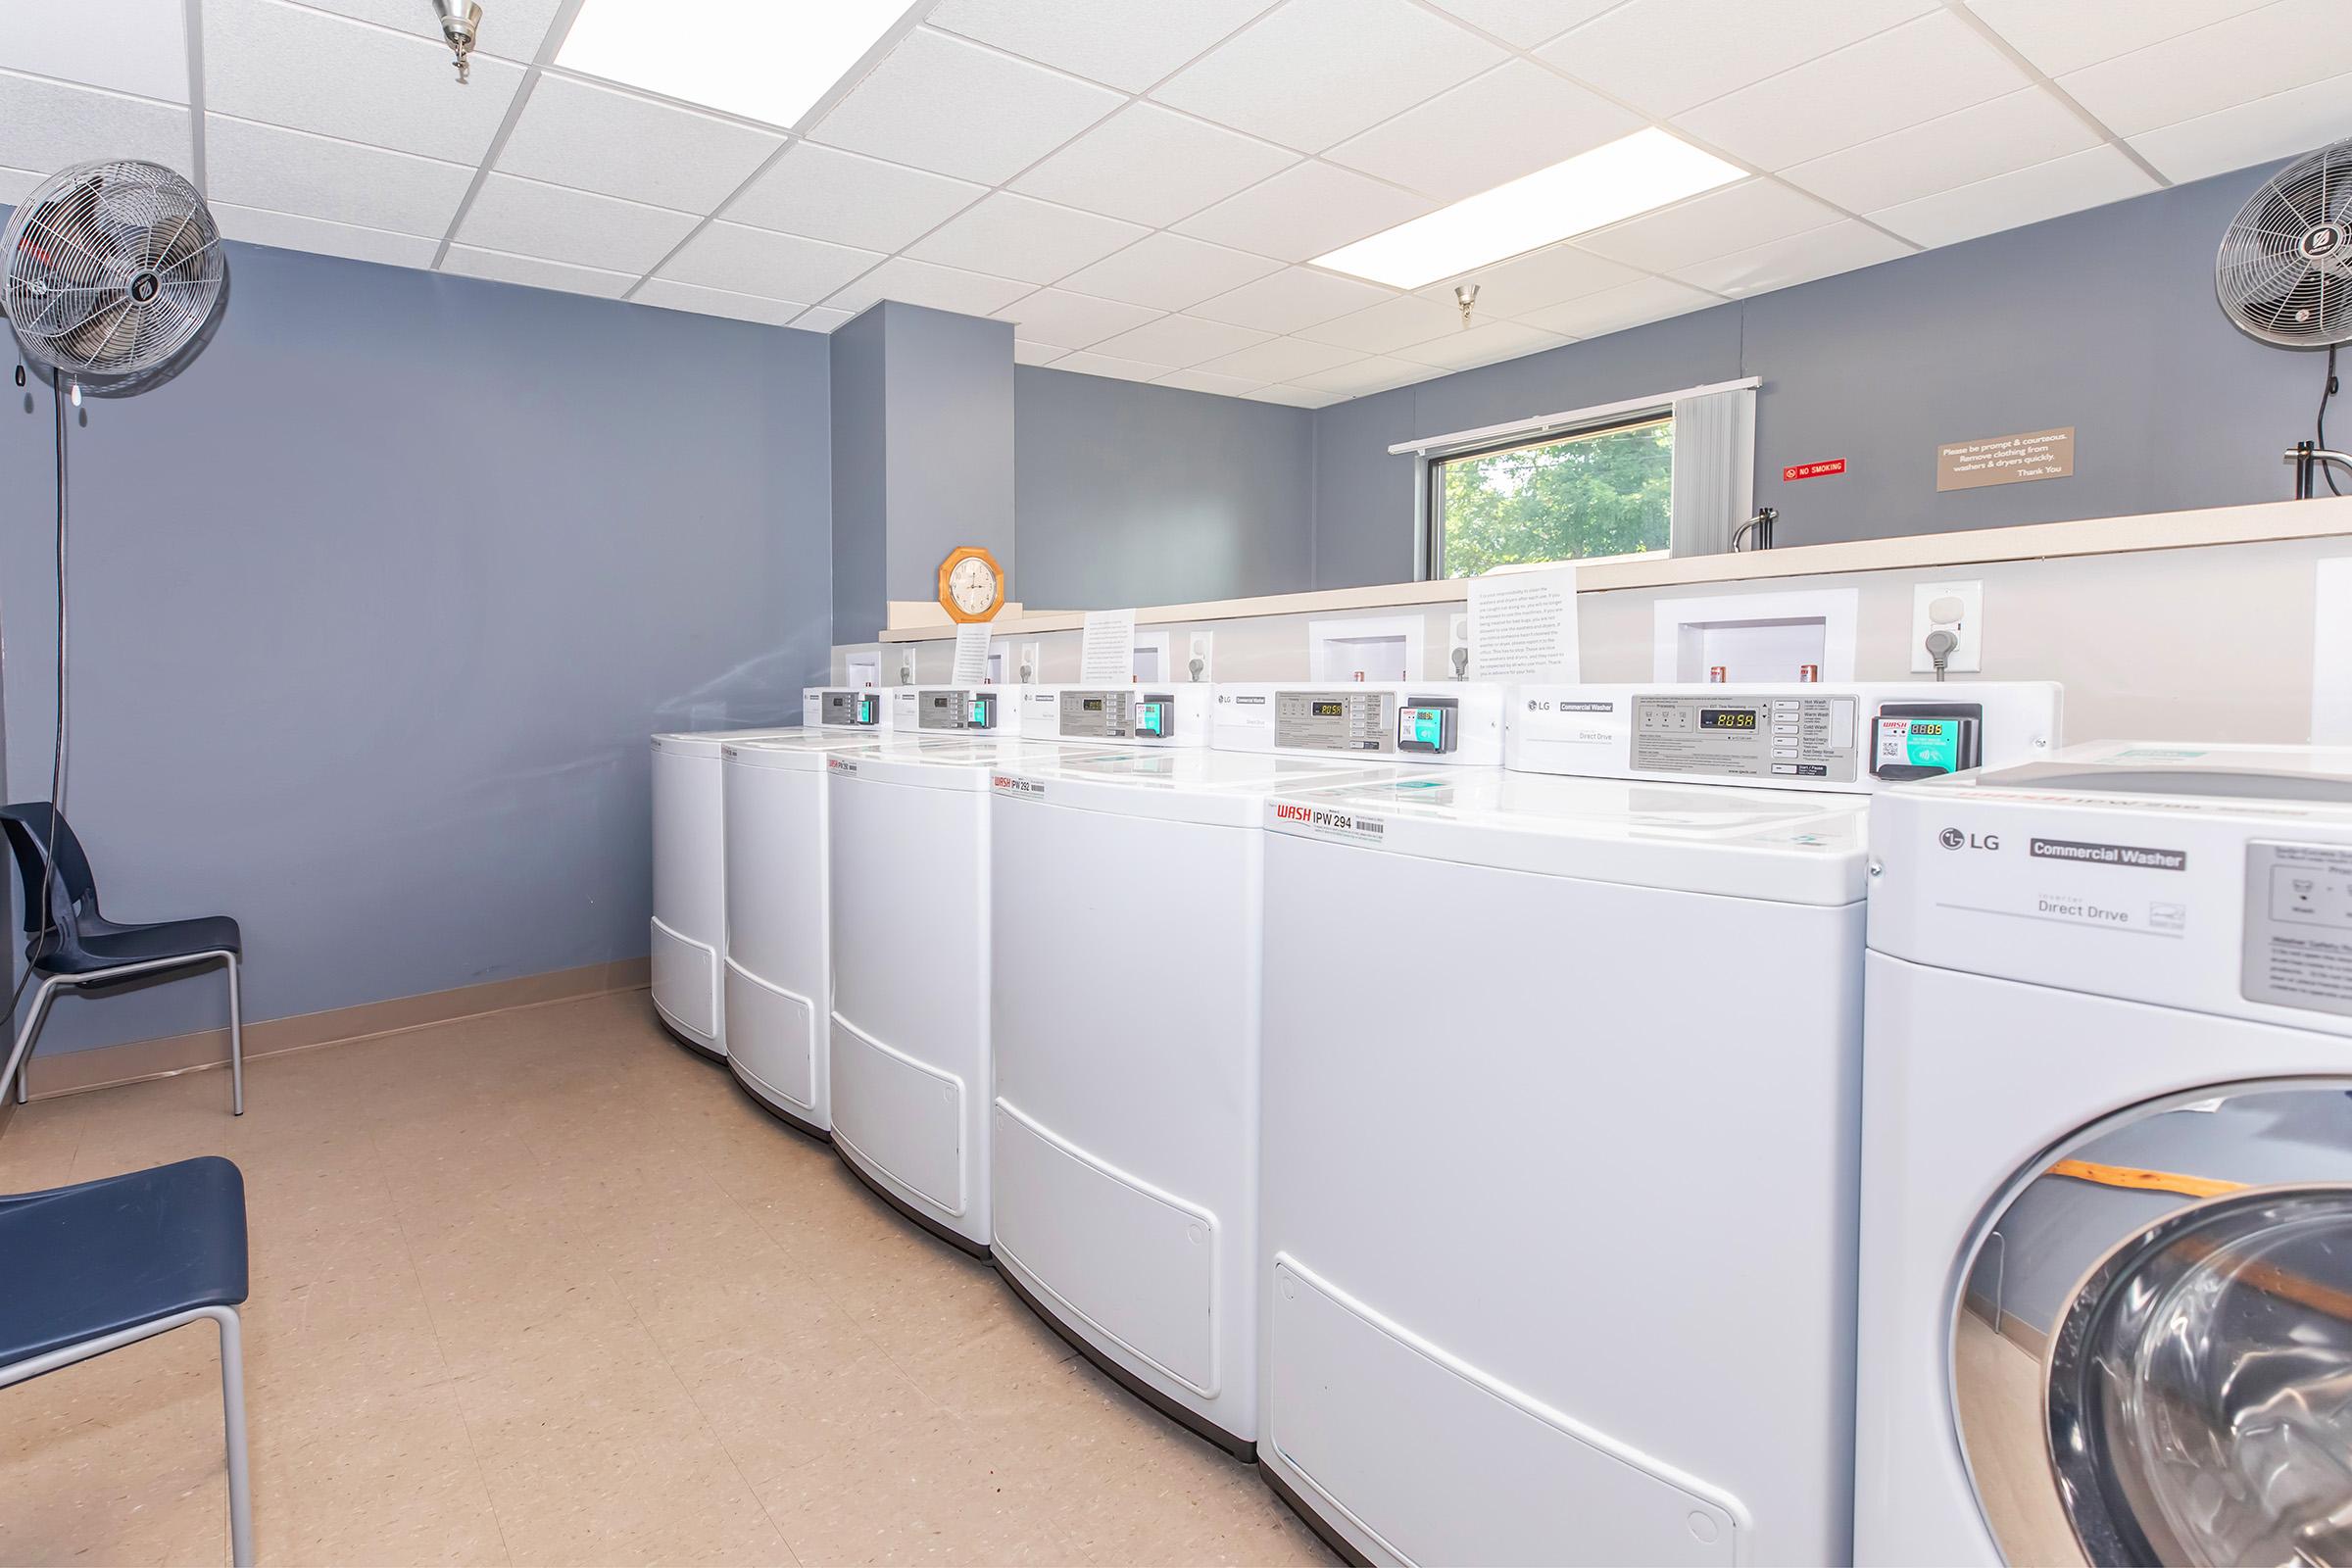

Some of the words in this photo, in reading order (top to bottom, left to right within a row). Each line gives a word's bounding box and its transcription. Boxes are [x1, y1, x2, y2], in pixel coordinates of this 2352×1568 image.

[1981, 441, 2012, 452] prompt
[2022, 433, 2067, 445] courteous.
[1953, 462, 1985, 471] washers
[1996, 458, 2023, 468] dryers
[2024, 453, 2055, 464] quickly.
[1959, 453, 1992, 463] Remove
[1993, 448, 2026, 459] clothing
[2027, 445, 2048, 454] from
[1811, 463, 1842, 473] SMOKING
[2018, 468, 2043, 477] Thank
[1277, 805, 1311, 822] WASH
[1313, 811, 1332, 826] IPW
[1334, 815, 1351, 829] 294
[1970, 833, 1999, 851] LG
[2034, 842, 2118, 861] Commercial
[2122, 850, 2182, 867] Washer
[2038, 900, 2083, 916] Direct
[2087, 906, 2129, 922] Drive
